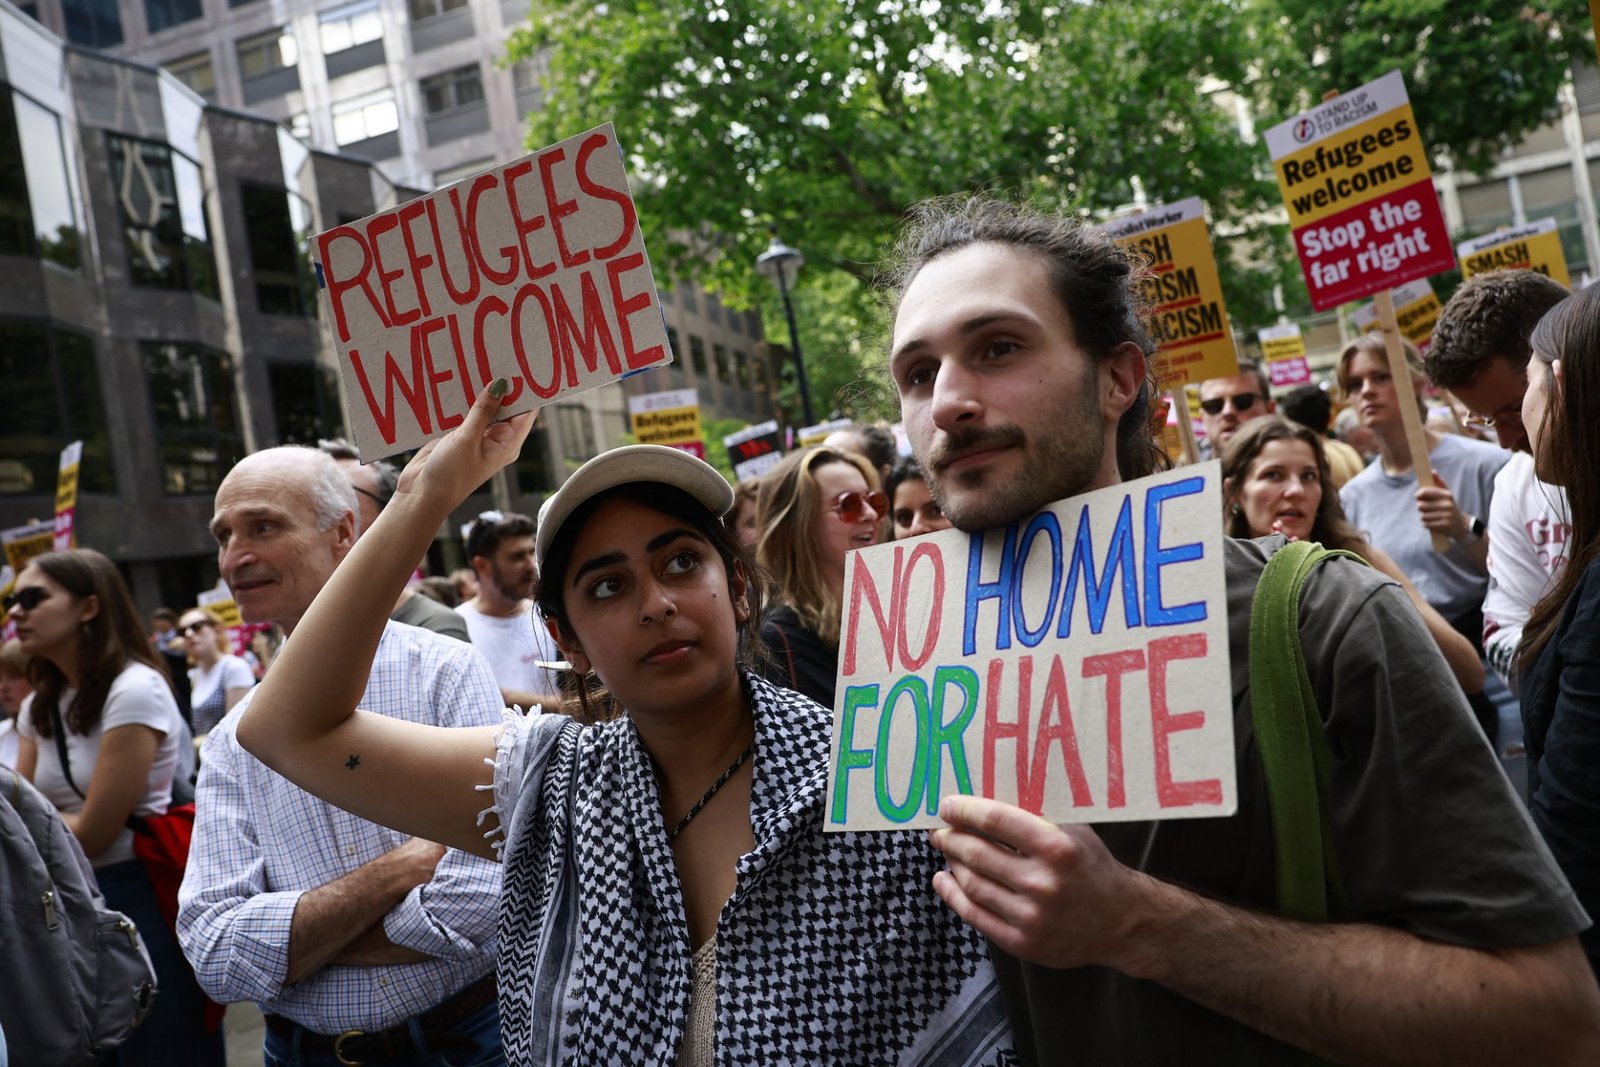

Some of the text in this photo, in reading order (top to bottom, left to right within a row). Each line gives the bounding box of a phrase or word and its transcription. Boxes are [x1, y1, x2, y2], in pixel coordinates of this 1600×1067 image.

[1315, 91, 1369, 122] STAND UP
[1318, 101, 1379, 135] TO RACISM
[1282, 119, 1412, 187] Refugees
[1293, 154, 1414, 216] welcome
[318, 133, 637, 343] REFUGEES
[1301, 199, 1422, 258] Stop the
[1310, 257, 1351, 289] far
[1357, 227, 1431, 272] right
[1466, 242, 1531, 274] SMASH
[349, 252, 666, 446] WELCOME
[1150, 301, 1223, 342] ACISM
[636, 411, 696, 428] Refugees
[639, 427, 695, 442] welcome
[842, 475, 1208, 677] NO HOME
[830, 632, 1223, 825] FOR HATE
